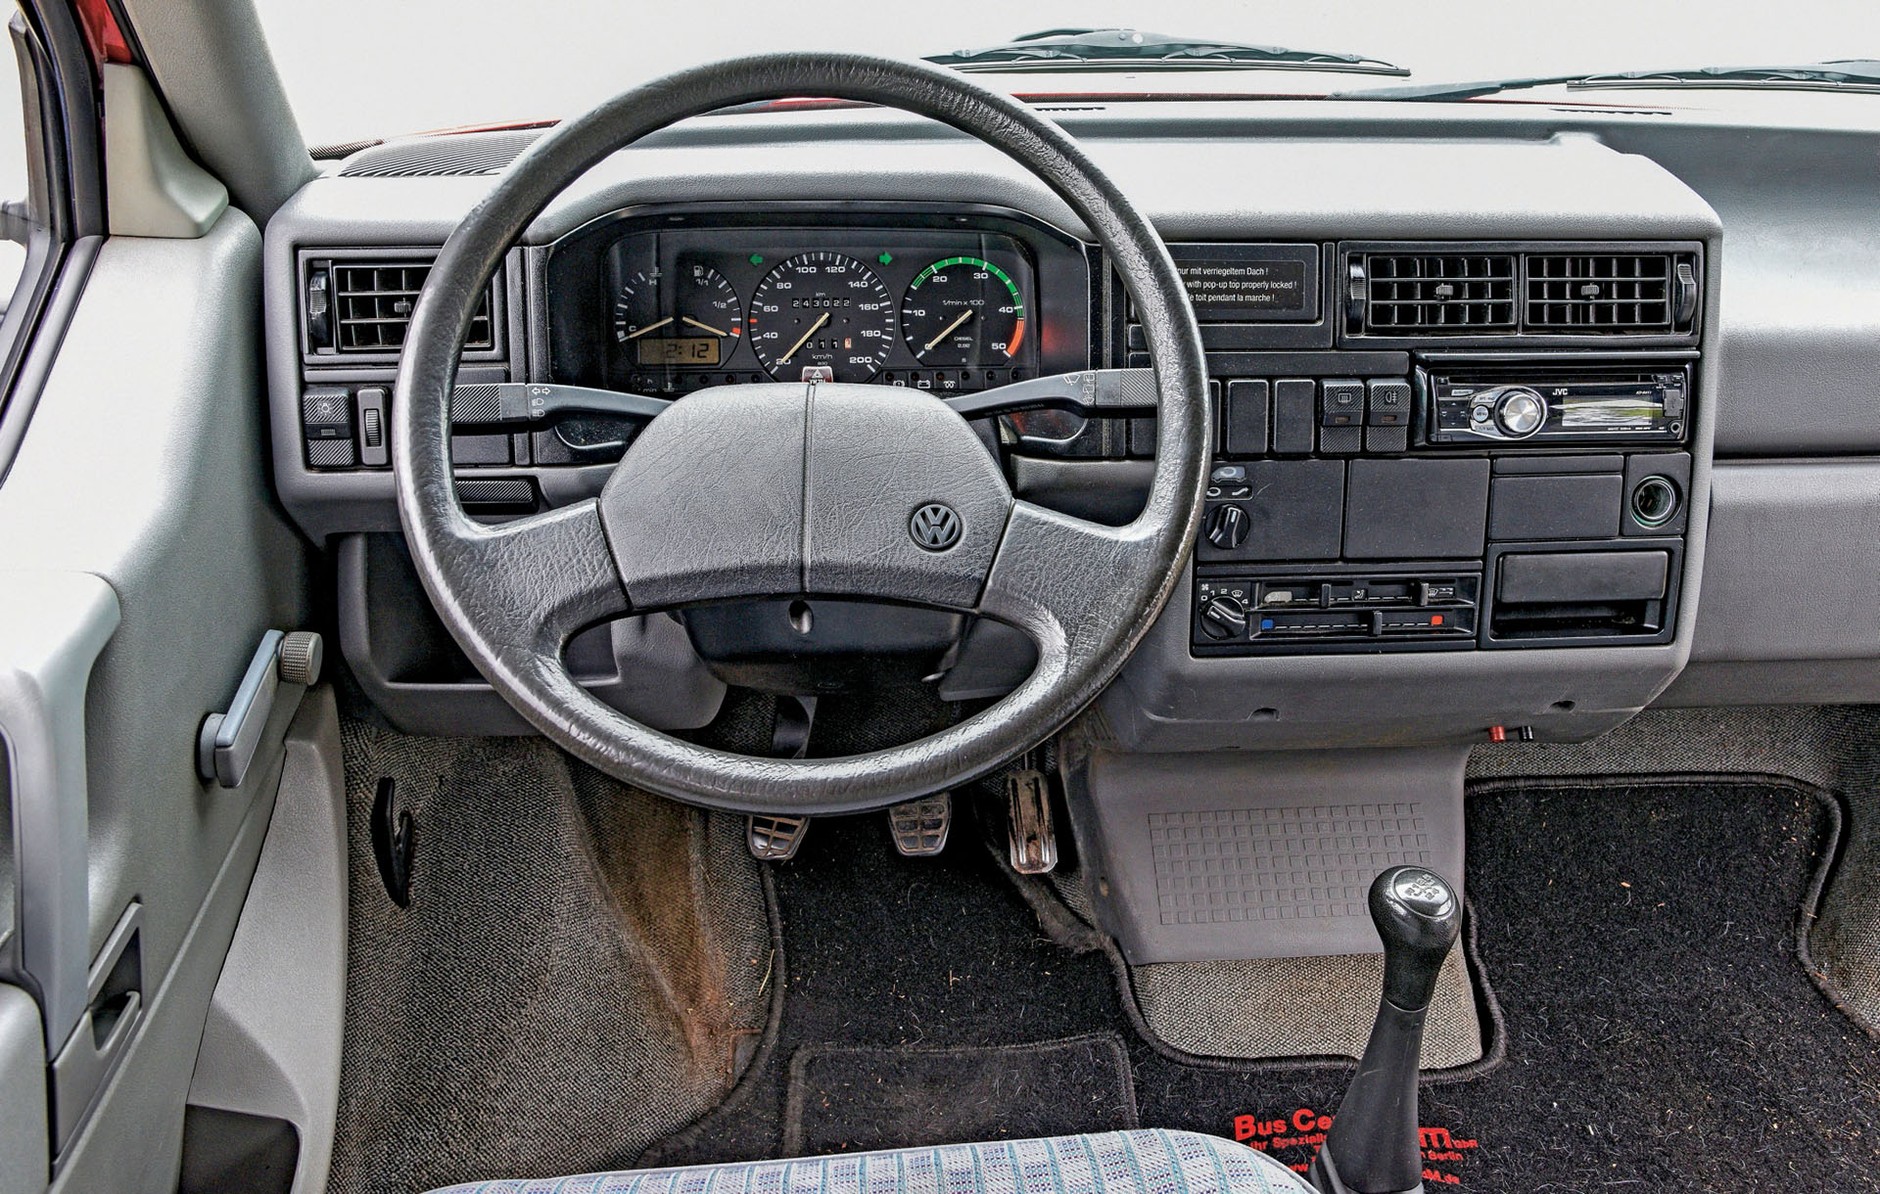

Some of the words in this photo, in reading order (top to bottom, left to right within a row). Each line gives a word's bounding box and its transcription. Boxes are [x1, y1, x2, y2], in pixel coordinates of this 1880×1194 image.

[1190, 267, 1202, 275] mit
[1246, 267, 1264, 275] Dach
[1203, 281, 1228, 290] pop-up
[1229, 281, 1240, 290] top
[1241, 281, 1269, 291] properly
[1270, 281, 1293, 289] locked
[1207, 294, 1236, 303] pendant
[666, 343, 710, 359] 2:12
[991, 342, 1007, 350] 50
[1552, 388, 1568, 396] JVC
[911, 504, 961, 548] VW
[1234, 1114, 1287, 1141] Bus
[1292, 1108, 1335, 1131] Ce
[1428, 1151, 1464, 1161] Berlin
